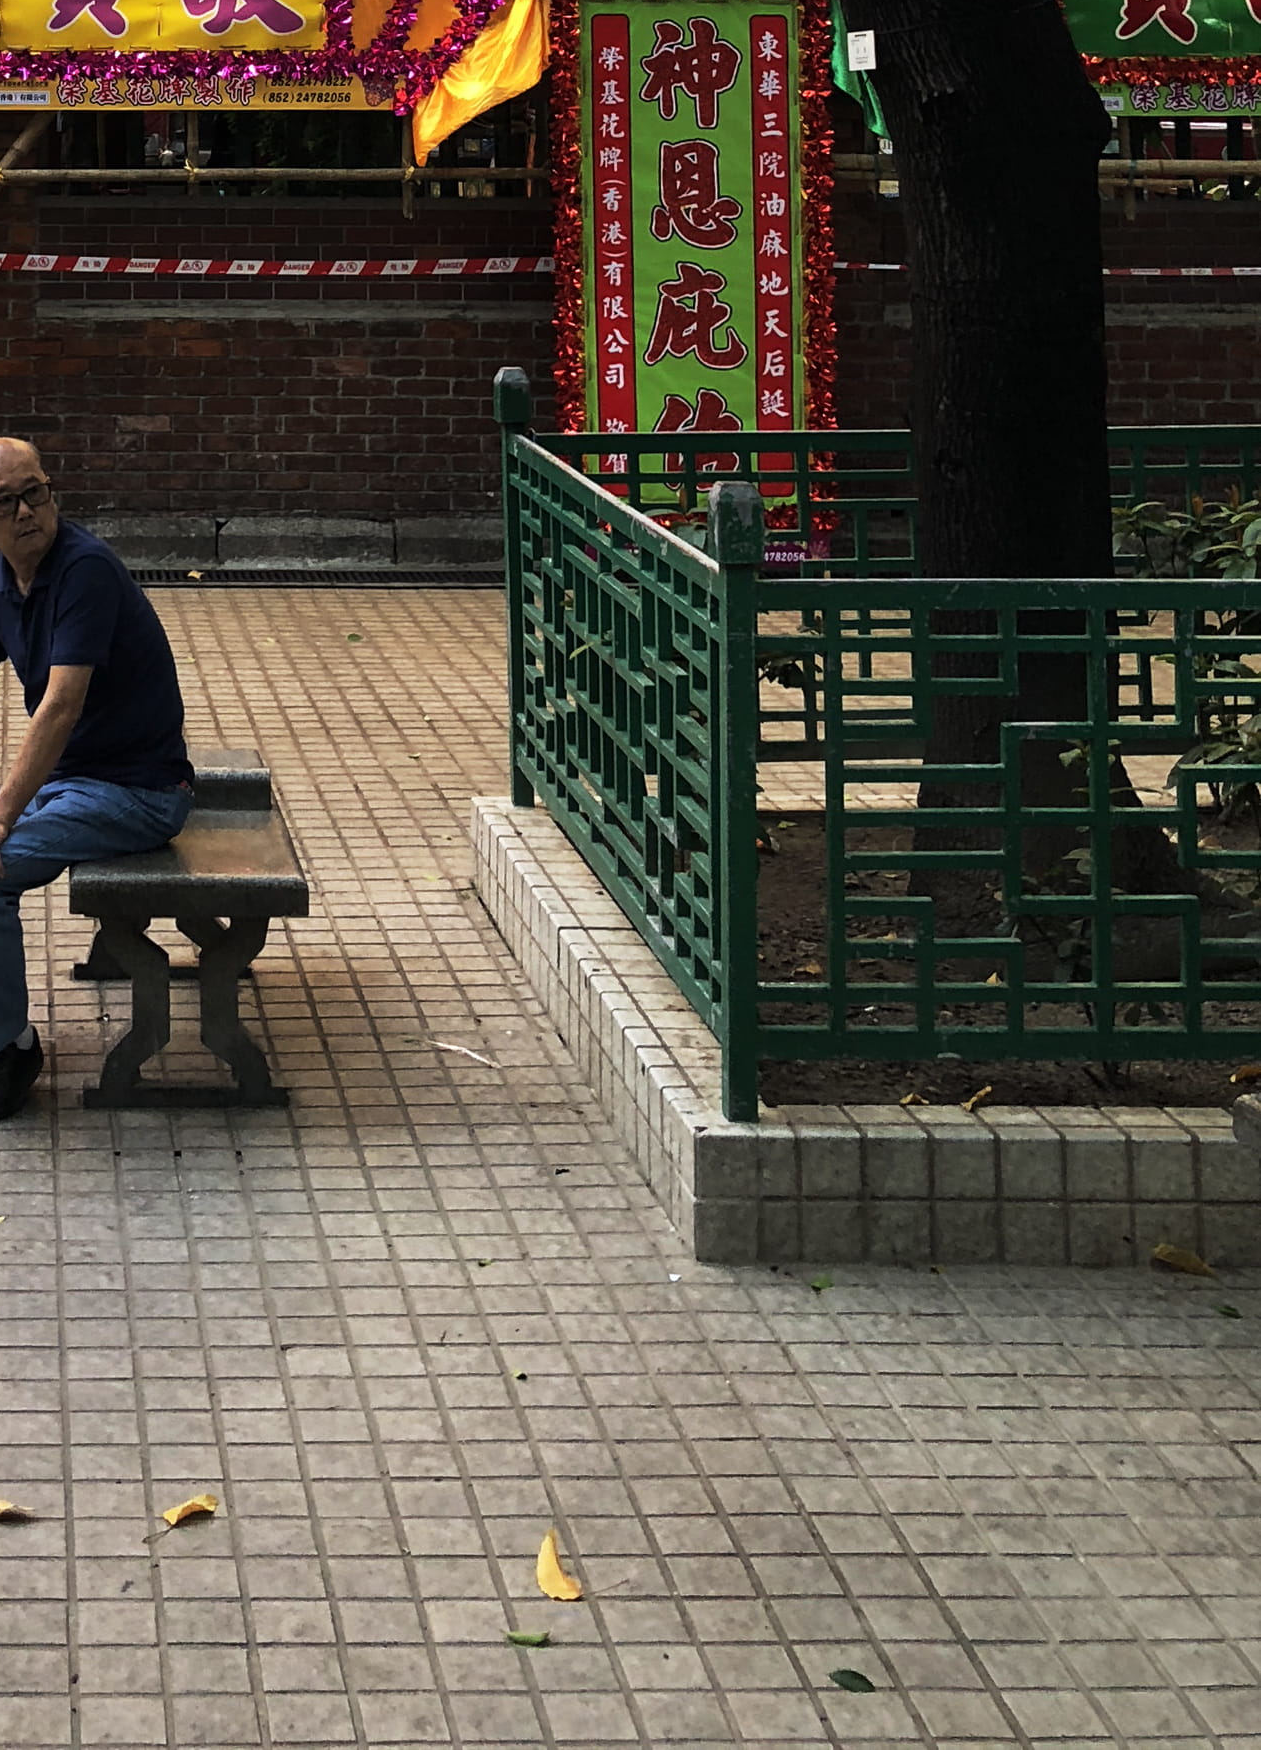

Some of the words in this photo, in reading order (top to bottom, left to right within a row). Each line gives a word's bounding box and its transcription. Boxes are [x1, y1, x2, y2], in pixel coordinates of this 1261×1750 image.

[57, 75, 256, 107] 榮基花牌製作
[262, 92, 352, 104] (852)24782056
[757, 28, 790, 418] 東華三院油麻地天后誕
